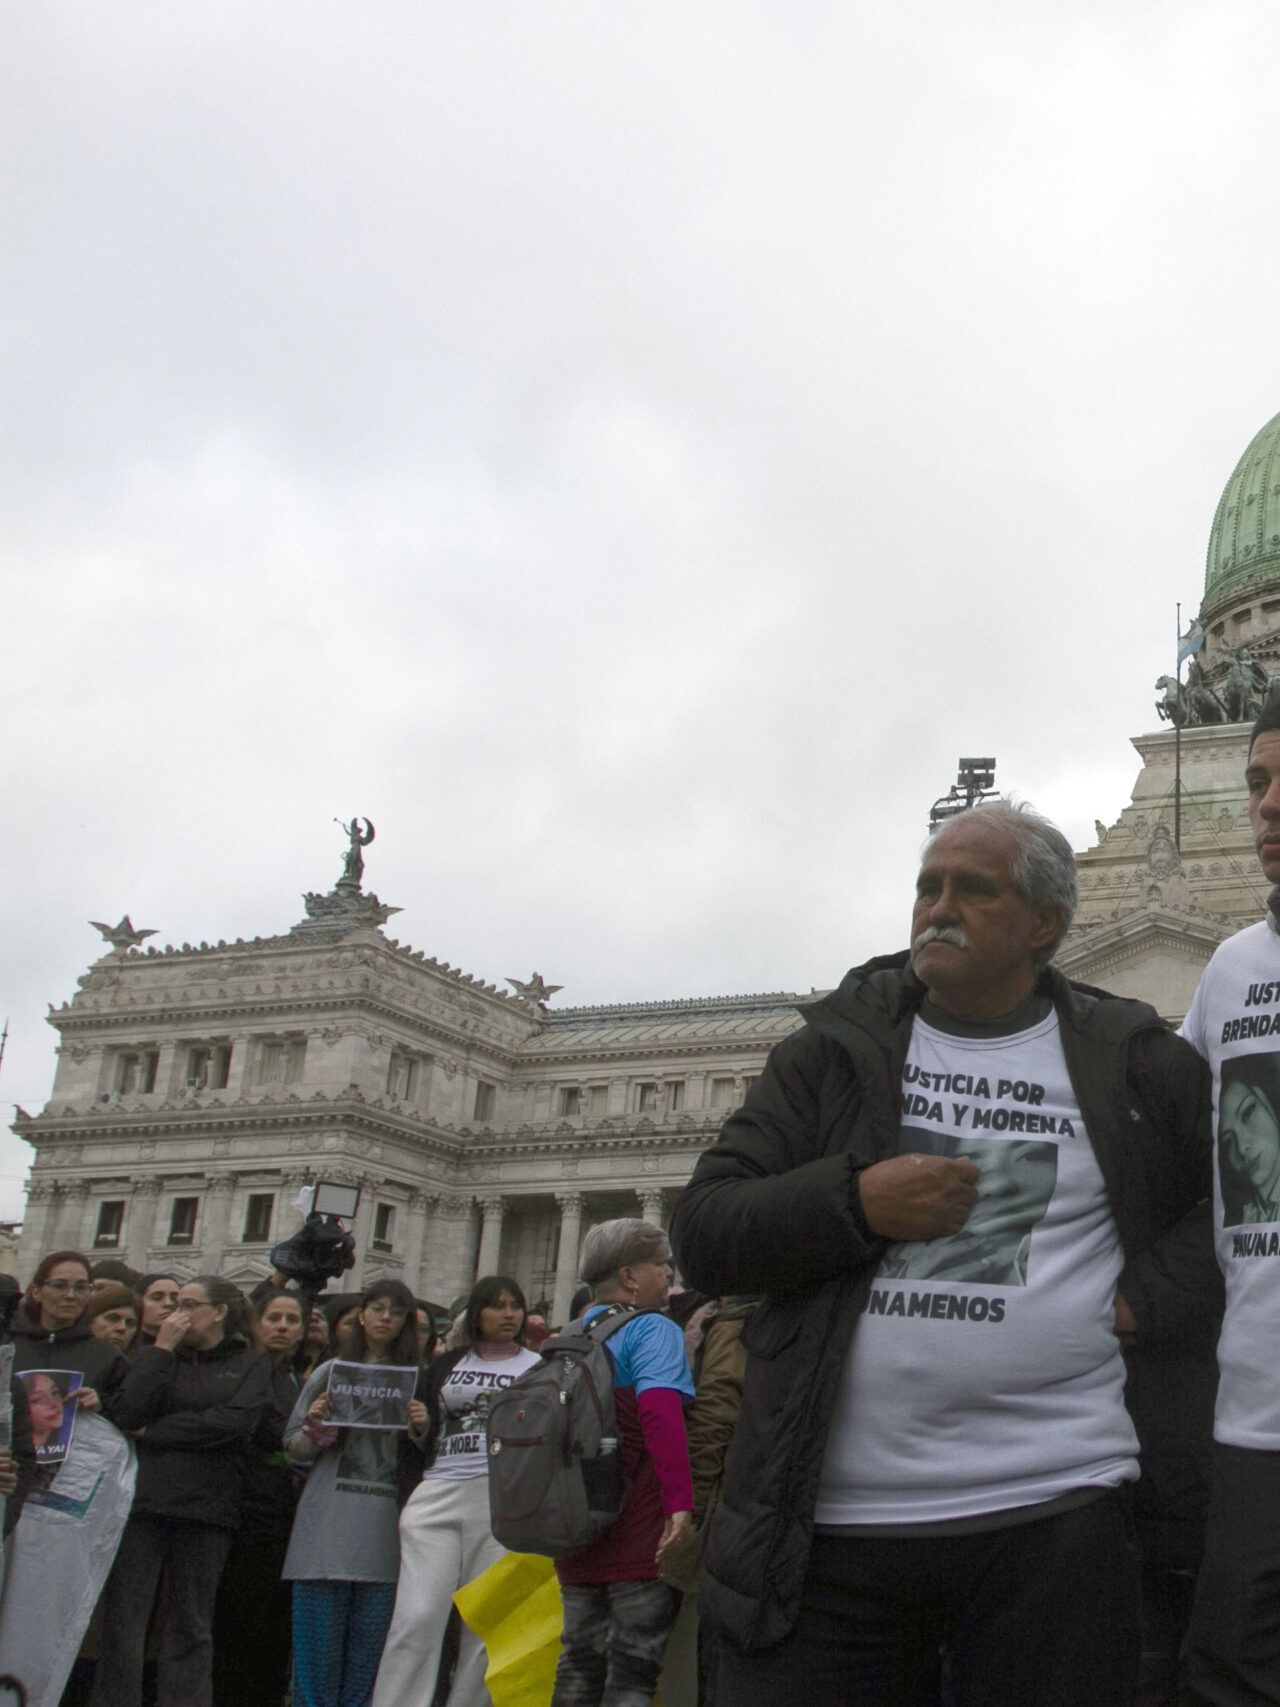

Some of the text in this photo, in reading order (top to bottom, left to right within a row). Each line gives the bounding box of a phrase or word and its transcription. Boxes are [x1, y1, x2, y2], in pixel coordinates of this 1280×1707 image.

[902, 1063, 1045, 1106] USTICIA POR
[901, 1092, 1075, 1138] NDA Y MORENA
[864, 1290, 1006, 1323] NAMENOS
[332, 1384, 401, 1399] JUSTICIA
